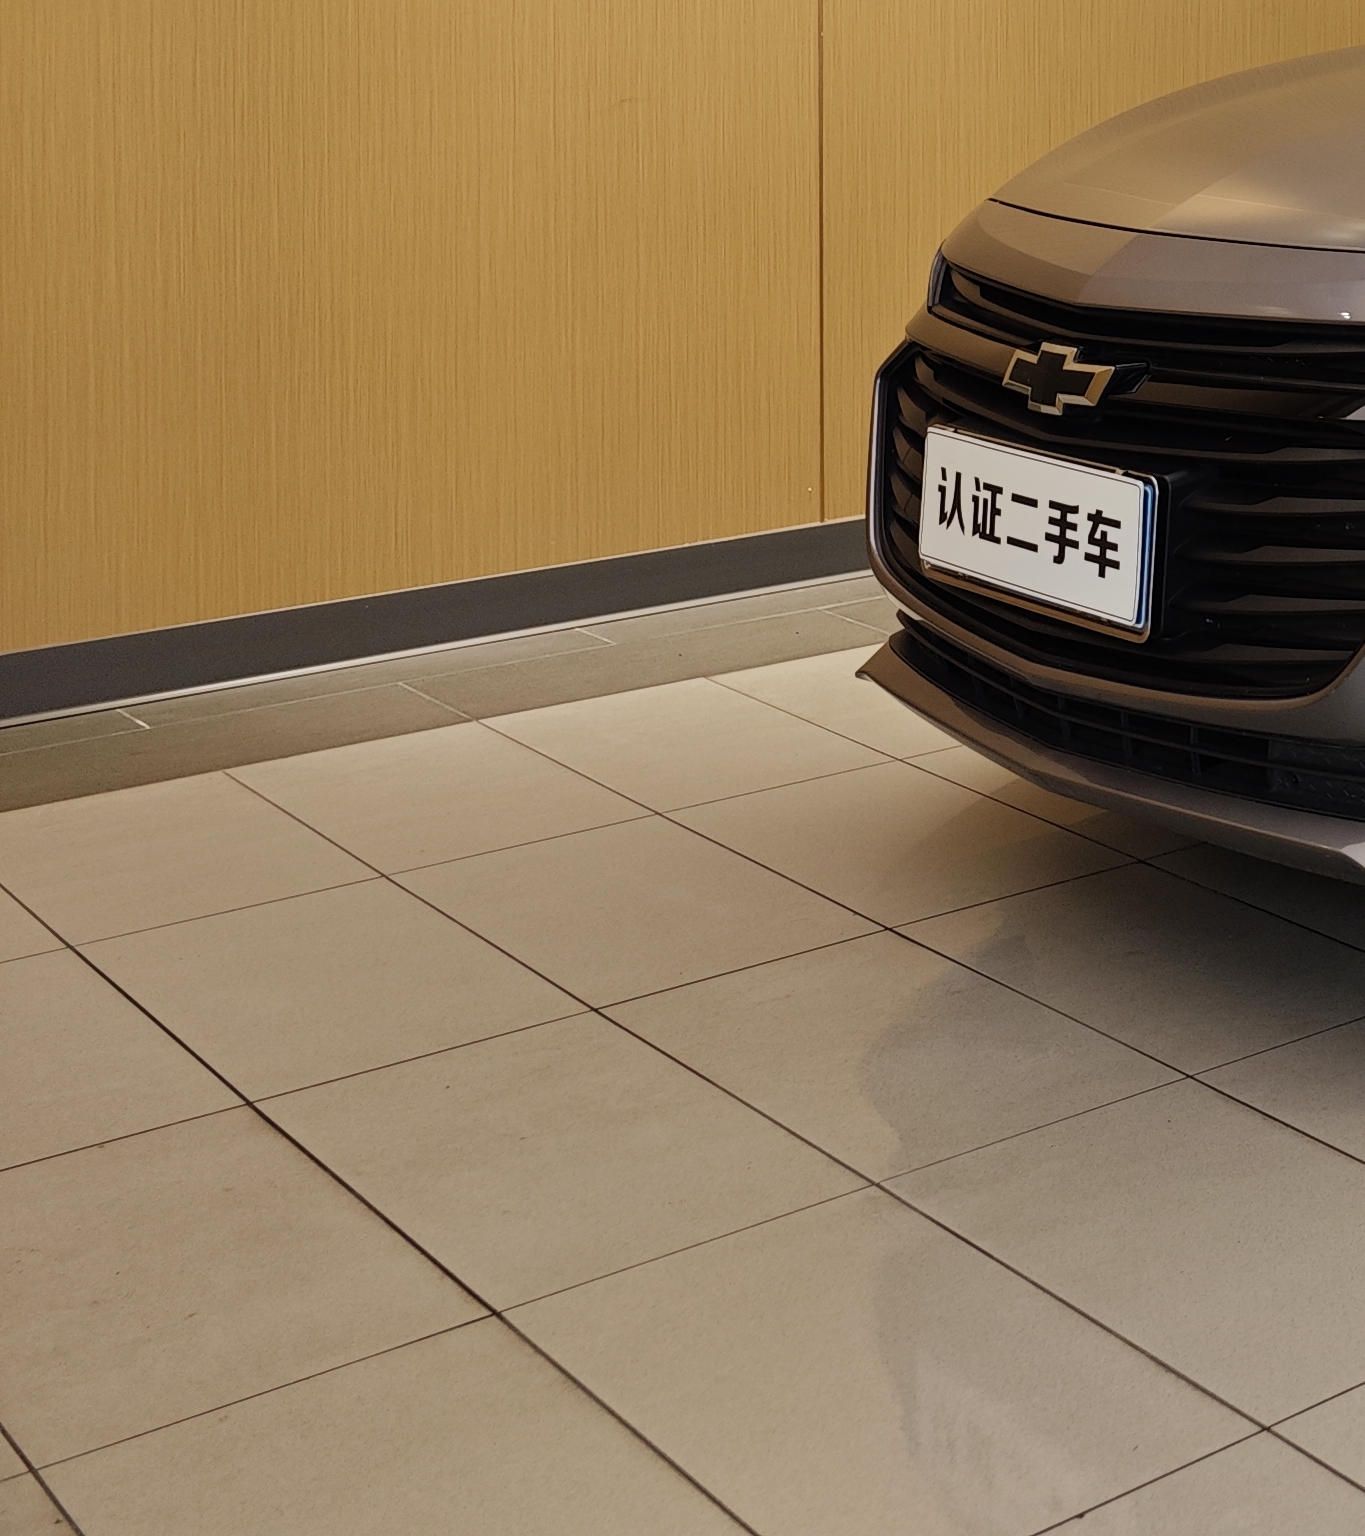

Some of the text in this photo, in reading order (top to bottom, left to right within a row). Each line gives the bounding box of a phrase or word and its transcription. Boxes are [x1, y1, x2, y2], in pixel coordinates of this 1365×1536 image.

[938, 466, 1122, 579] 认证二手车
